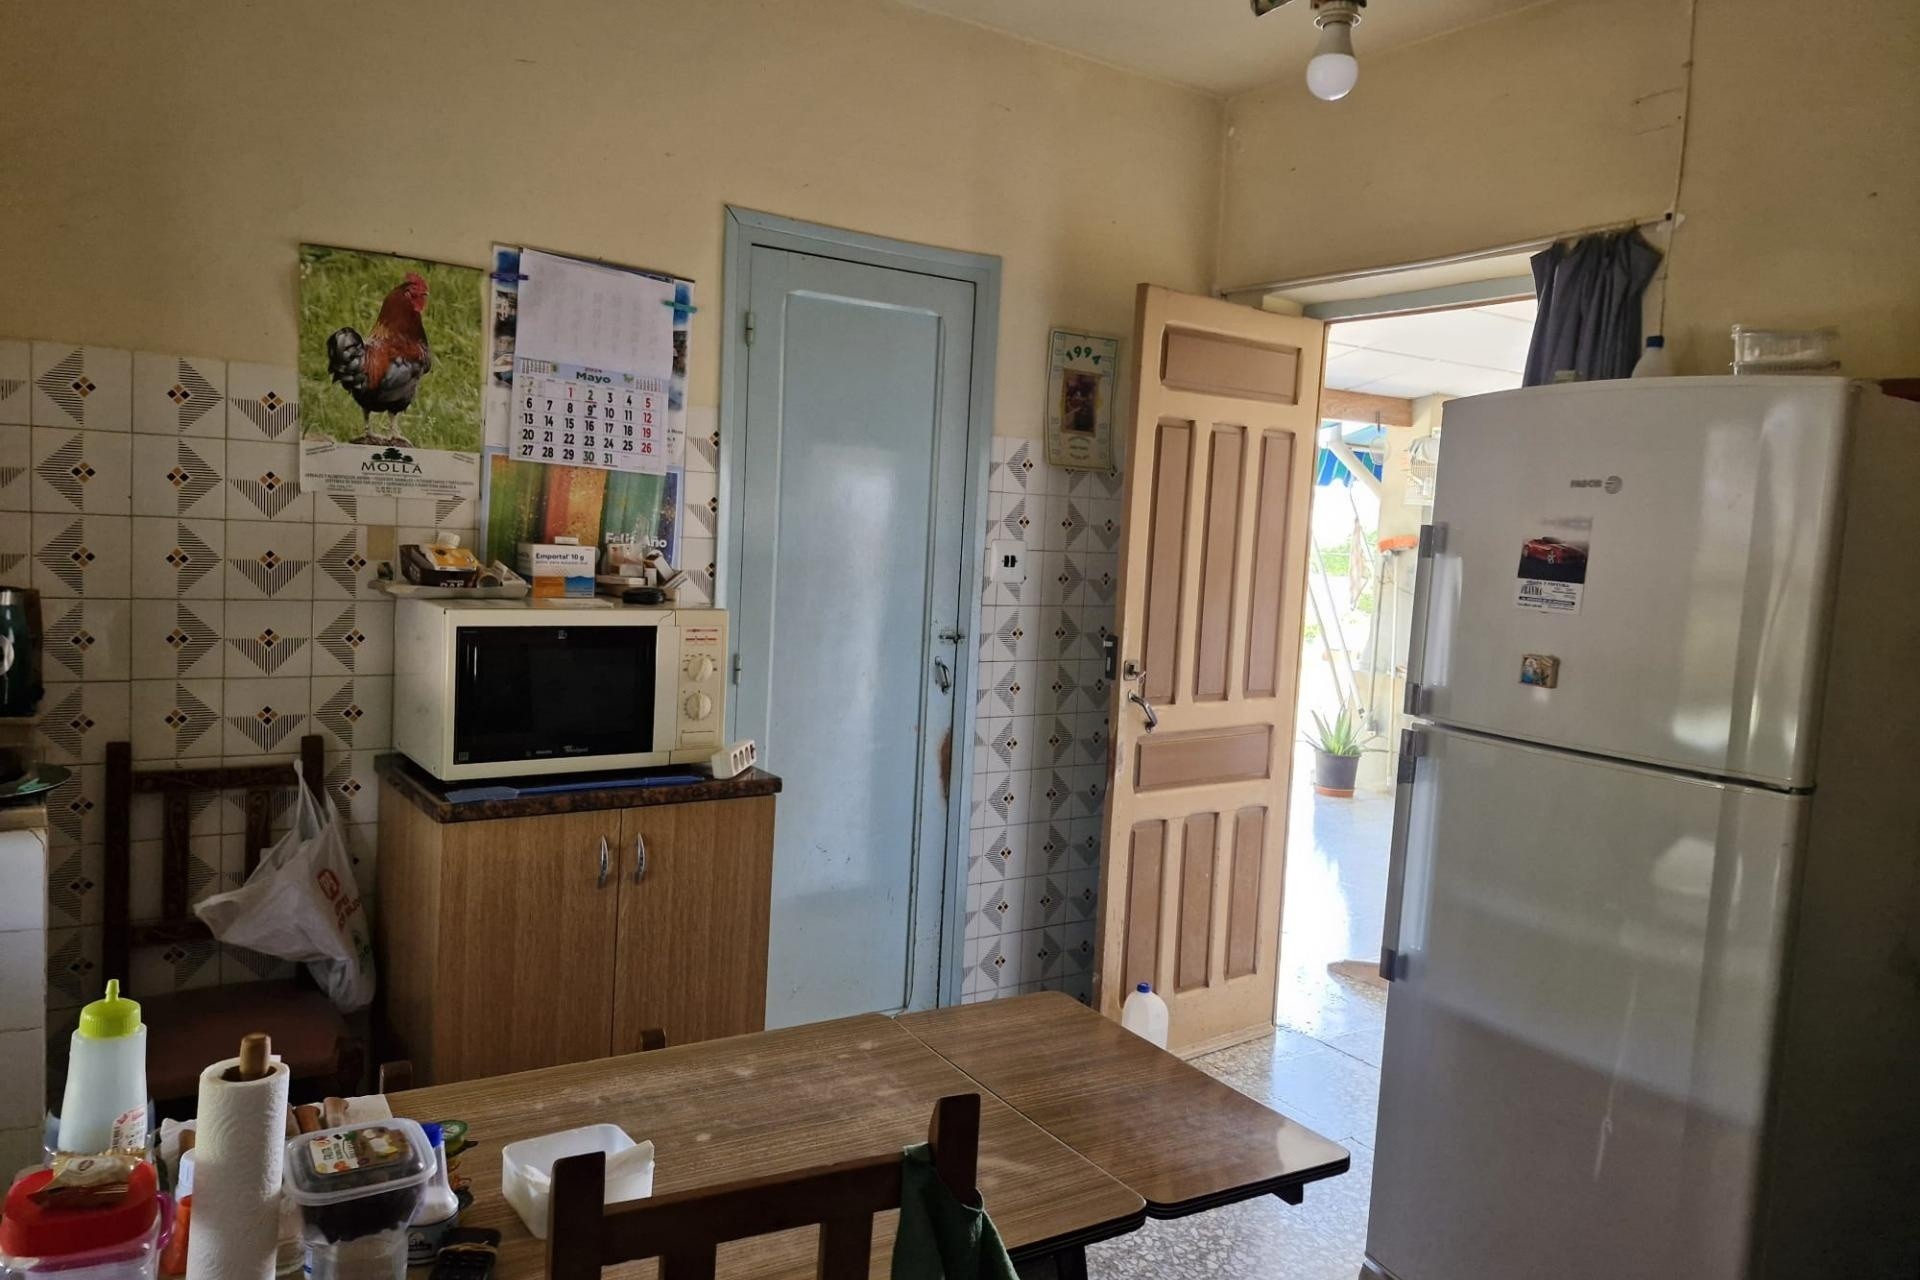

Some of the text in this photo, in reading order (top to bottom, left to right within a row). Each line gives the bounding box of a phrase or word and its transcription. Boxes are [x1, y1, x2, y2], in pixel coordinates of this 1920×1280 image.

[576, 371, 611, 384] Mayo
[568, 387, 651, 408] 1 2 3 4 5
[526, 397, 533, 409] 6
[547, 400, 553, 411] 7
[567, 402, 573, 414] 8
[605, 407, 614, 419] 10
[624, 410, 632, 421] 11
[643, 412, 652, 424] 12
[524, 413, 651, 438] 13 14 15 16 17 18 19
[522, 429, 652, 454] 20 21 22 23 24 25 26
[522, 445, 613, 464] 27 28 29 30 31
[361, 462, 423, 474] MOLLA
